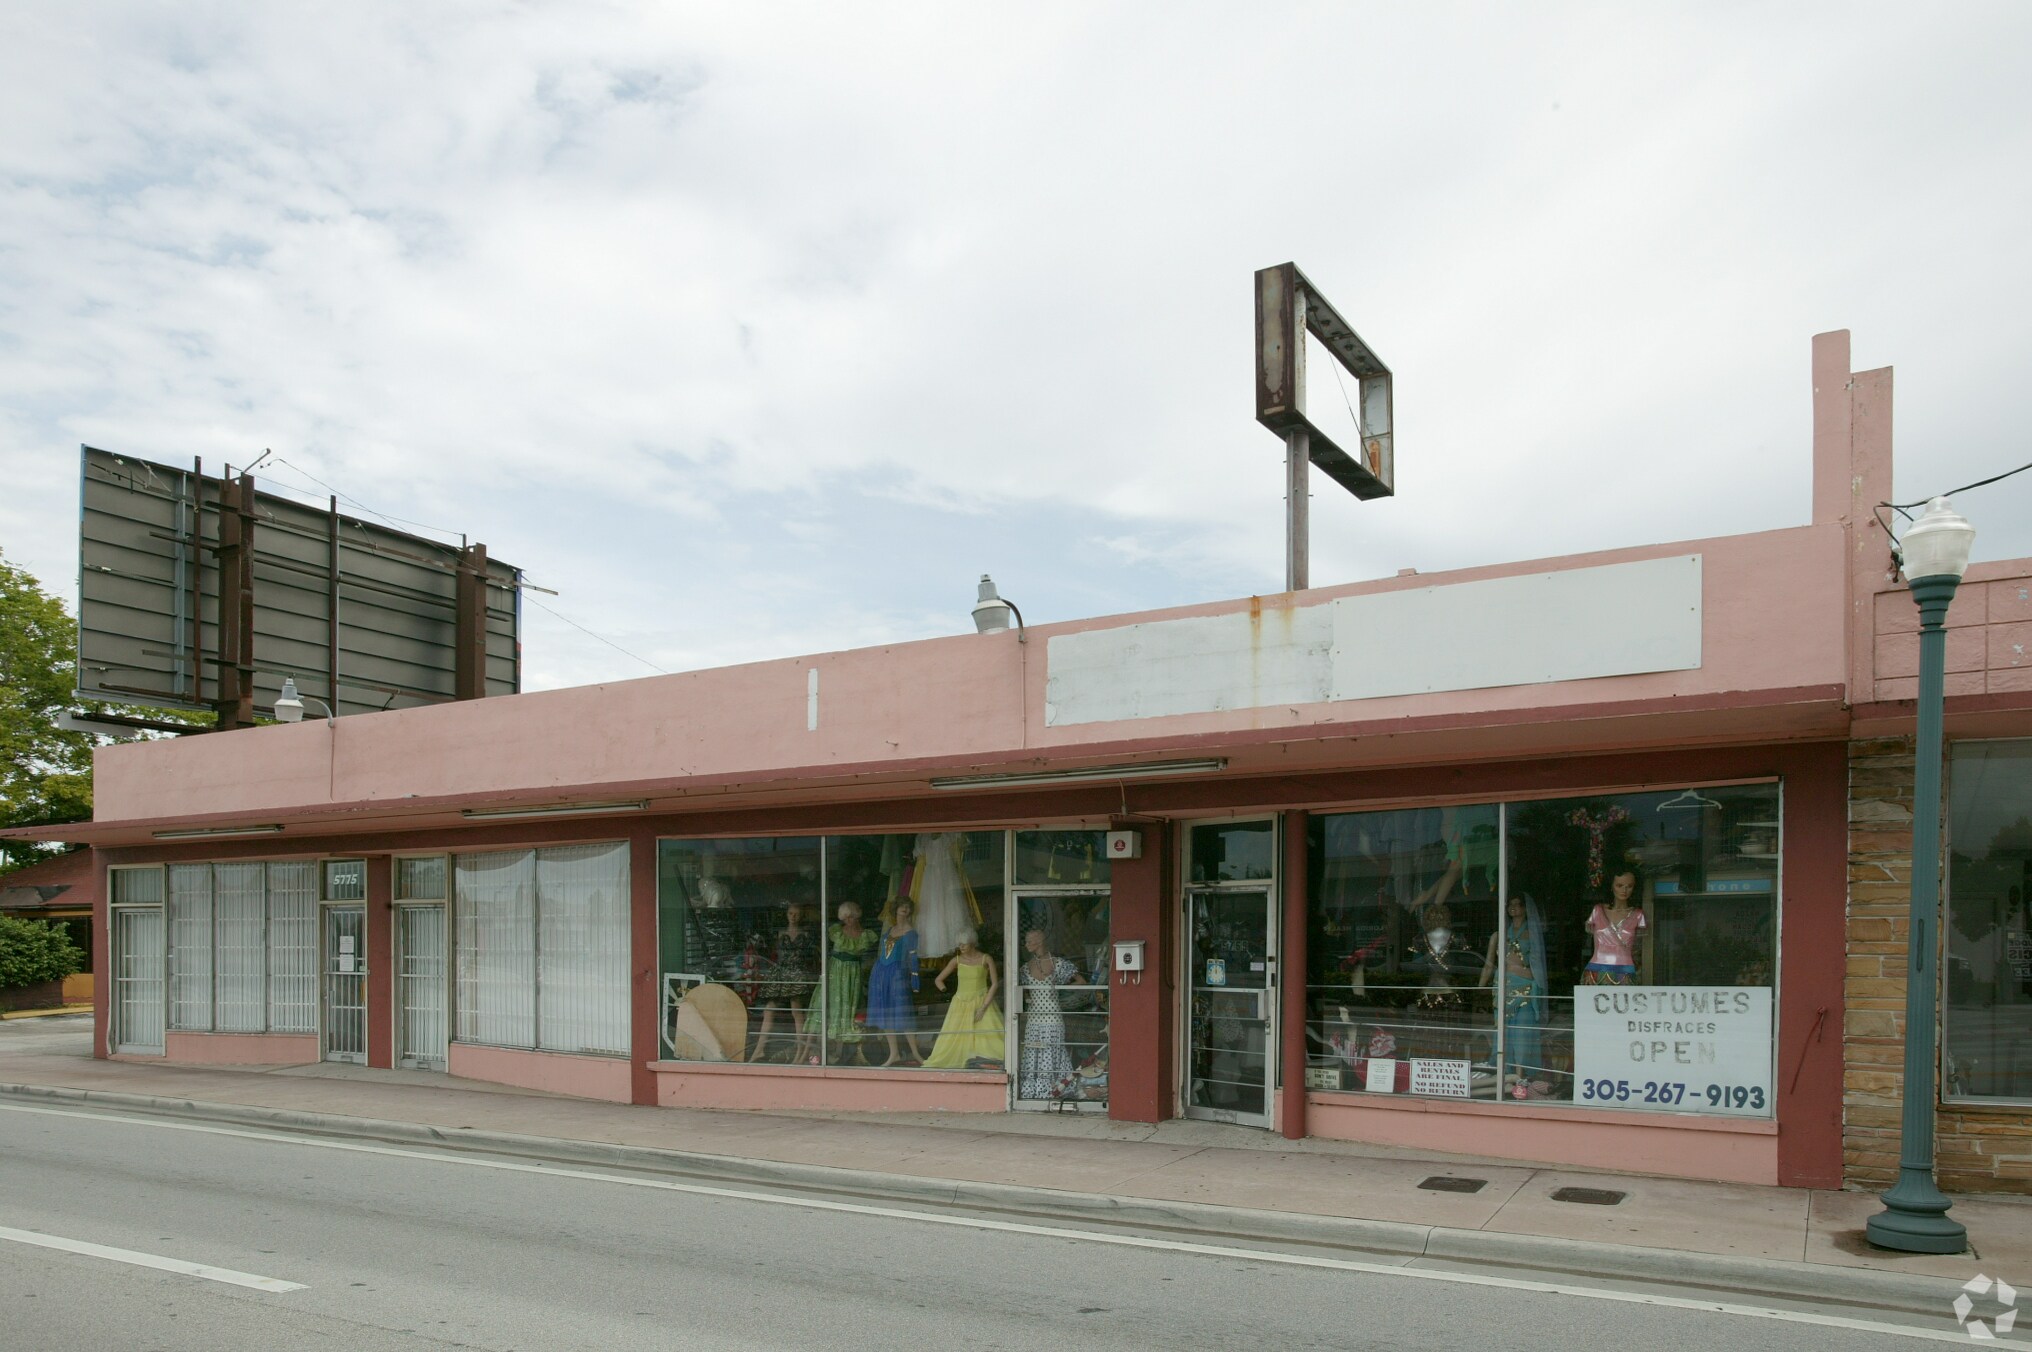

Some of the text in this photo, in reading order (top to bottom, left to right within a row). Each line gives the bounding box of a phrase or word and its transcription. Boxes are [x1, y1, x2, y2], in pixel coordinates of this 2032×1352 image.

[333, 874, 358, 885] 5775
[1706, 882, 1751, 892] hone
[1593, 991, 1750, 1014] CUSTUMES
[1627, 1020, 1716, 1034] DISFRACES
[1629, 1040, 1716, 1064] OPEN
[1582, 1078, 1765, 1109] 305-267-9193
